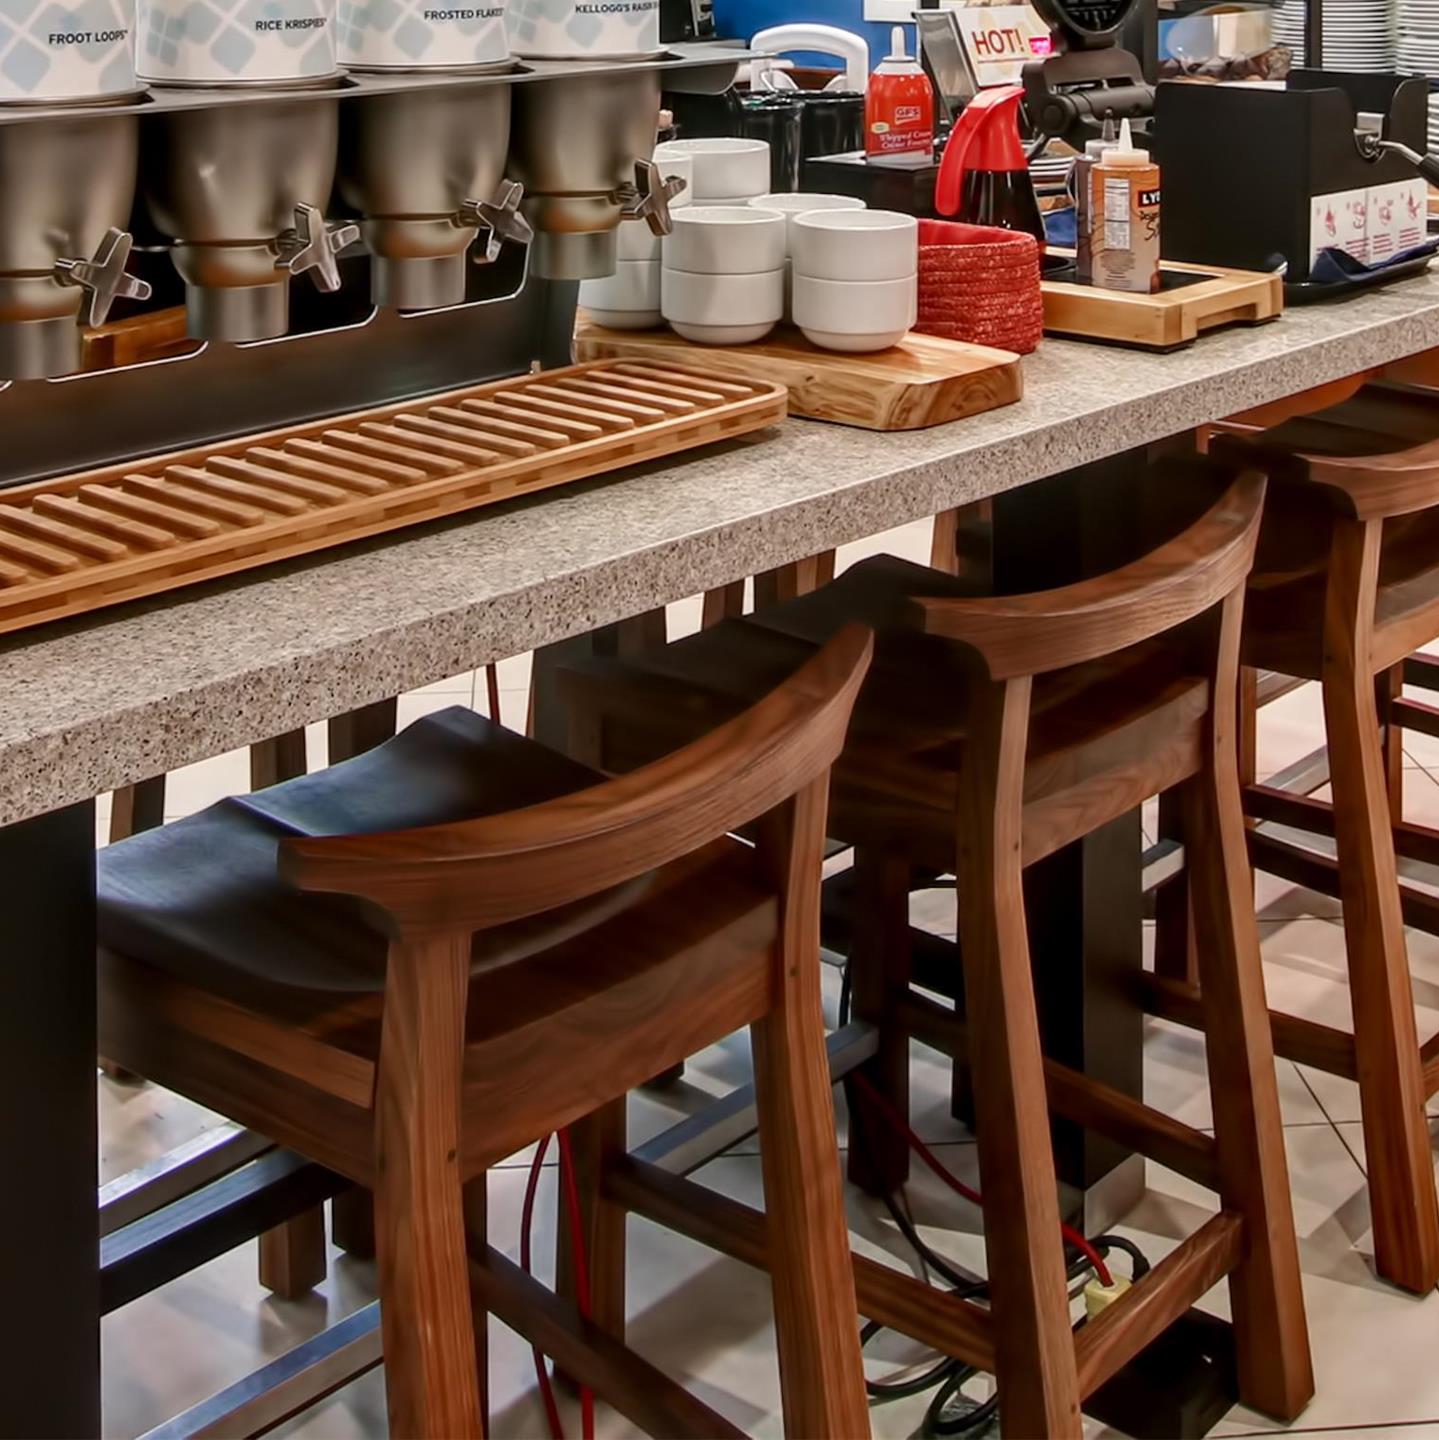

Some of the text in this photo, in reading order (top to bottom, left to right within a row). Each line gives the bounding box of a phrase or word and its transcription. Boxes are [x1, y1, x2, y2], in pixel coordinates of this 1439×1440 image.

[575, 3, 630, 14] KELLOGG'S
[424, 9, 474, 20] FROSTED
[255, 20, 282, 31] RICE
[48, 32, 92, 45] FROOT
[971, 28, 1024, 55] HOT!
